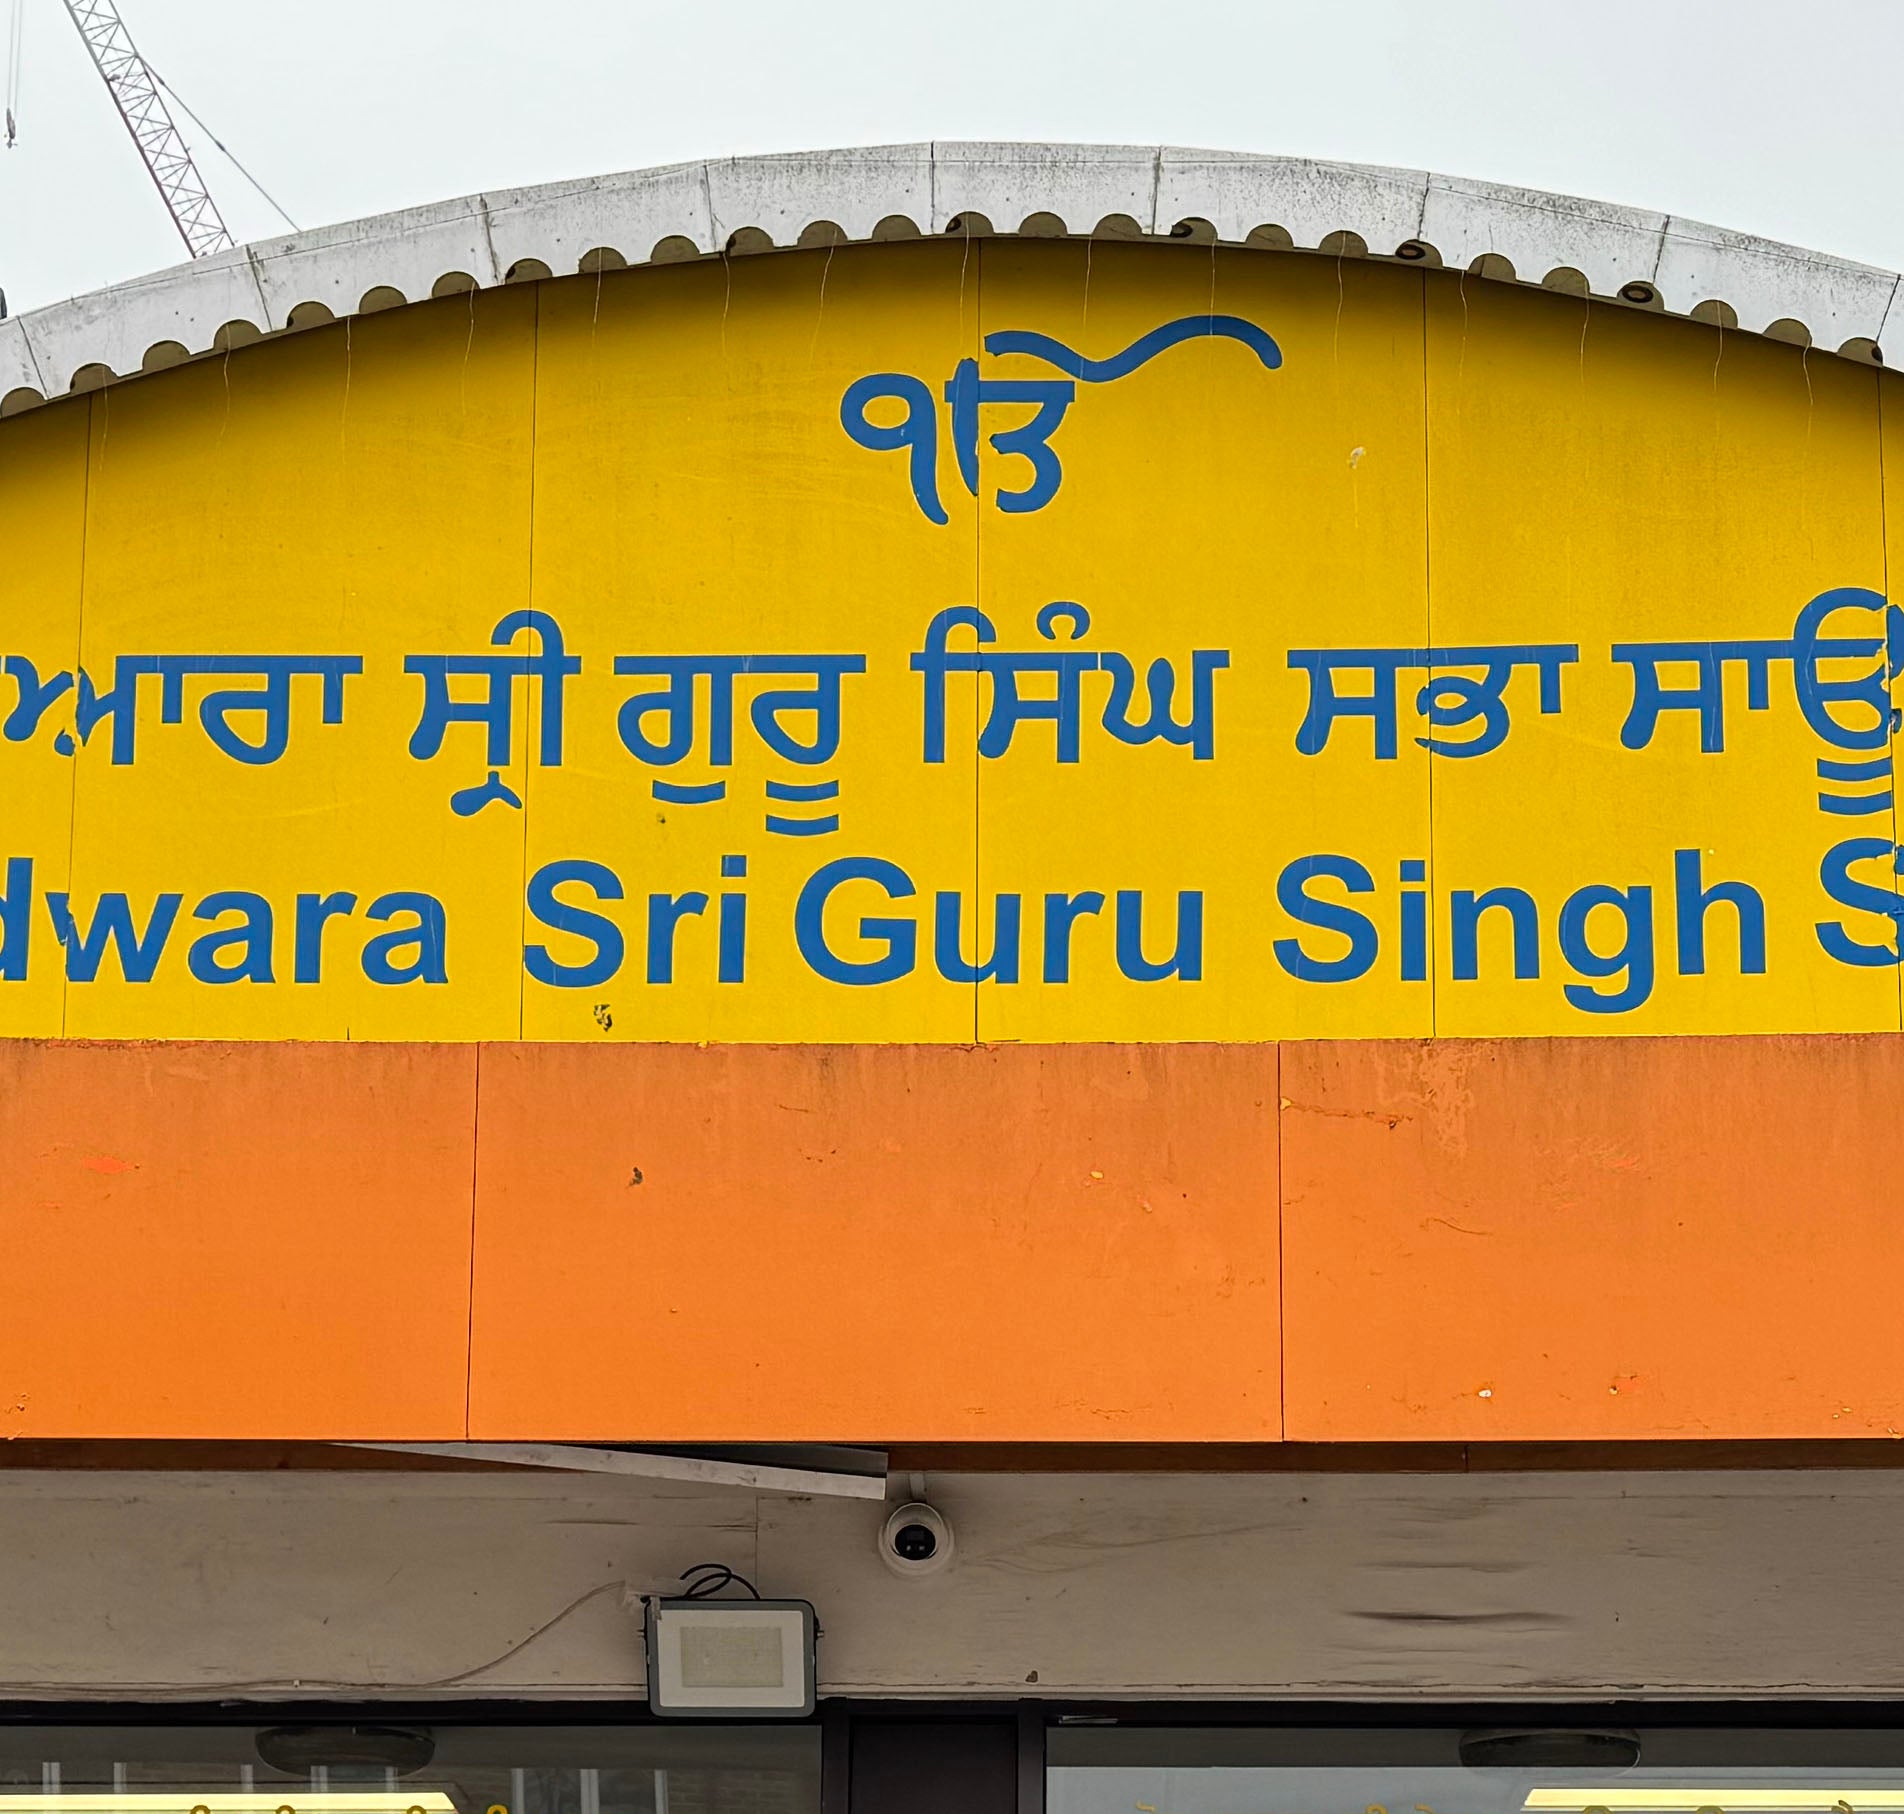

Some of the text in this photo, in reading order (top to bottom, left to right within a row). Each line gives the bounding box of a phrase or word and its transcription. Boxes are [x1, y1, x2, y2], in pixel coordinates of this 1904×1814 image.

[404, 608, 581, 817] ਸ੍ਰੀ
[613, 653, 867, 837] ਗੁਰੂ
[910, 600, 1230, 764] ਸਿੰਘ
[1286, 643, 1579, 760] ਸਭਾ
[523, 851, 748, 989] Sri
[792, 854, 1200, 988] Guru
[1272, 850, 1767, 1015] Singh
